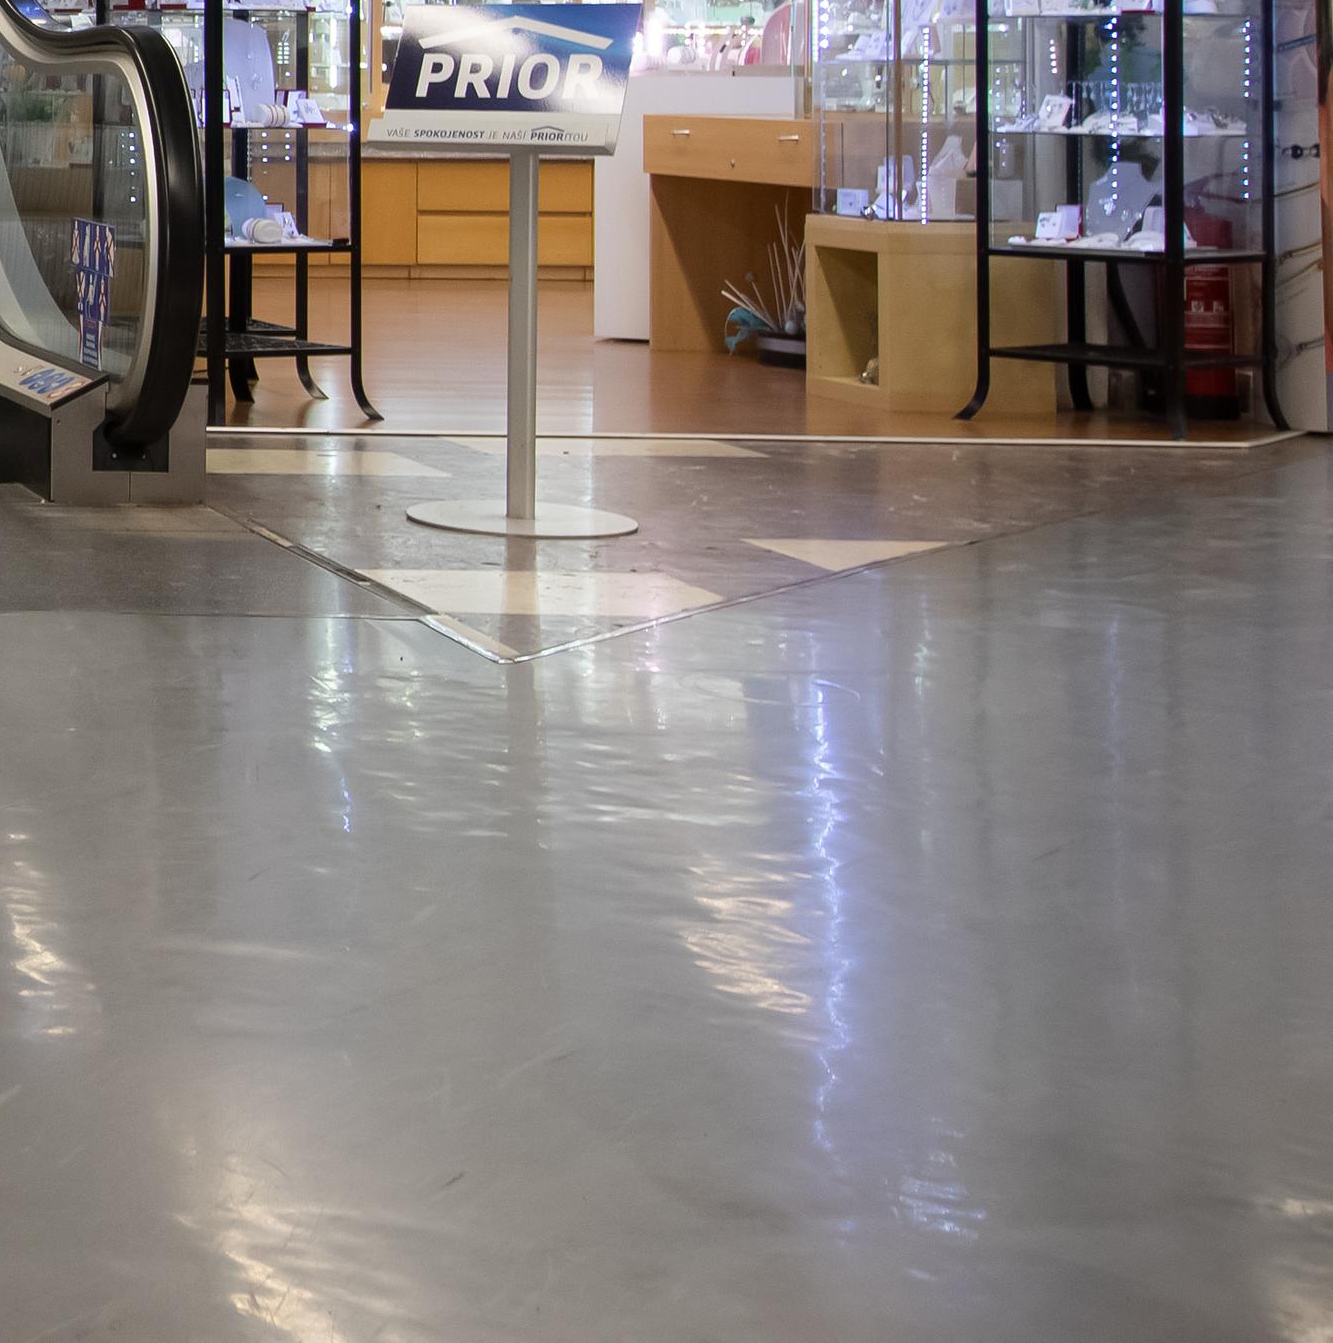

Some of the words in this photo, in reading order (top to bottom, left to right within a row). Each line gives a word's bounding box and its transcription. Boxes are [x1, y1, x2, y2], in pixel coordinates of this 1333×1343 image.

[415, 53, 605, 100] PRIOR
[386, 127, 410, 138] VAŠE
[413, 129, 485, 139] SPOKOJENOST
